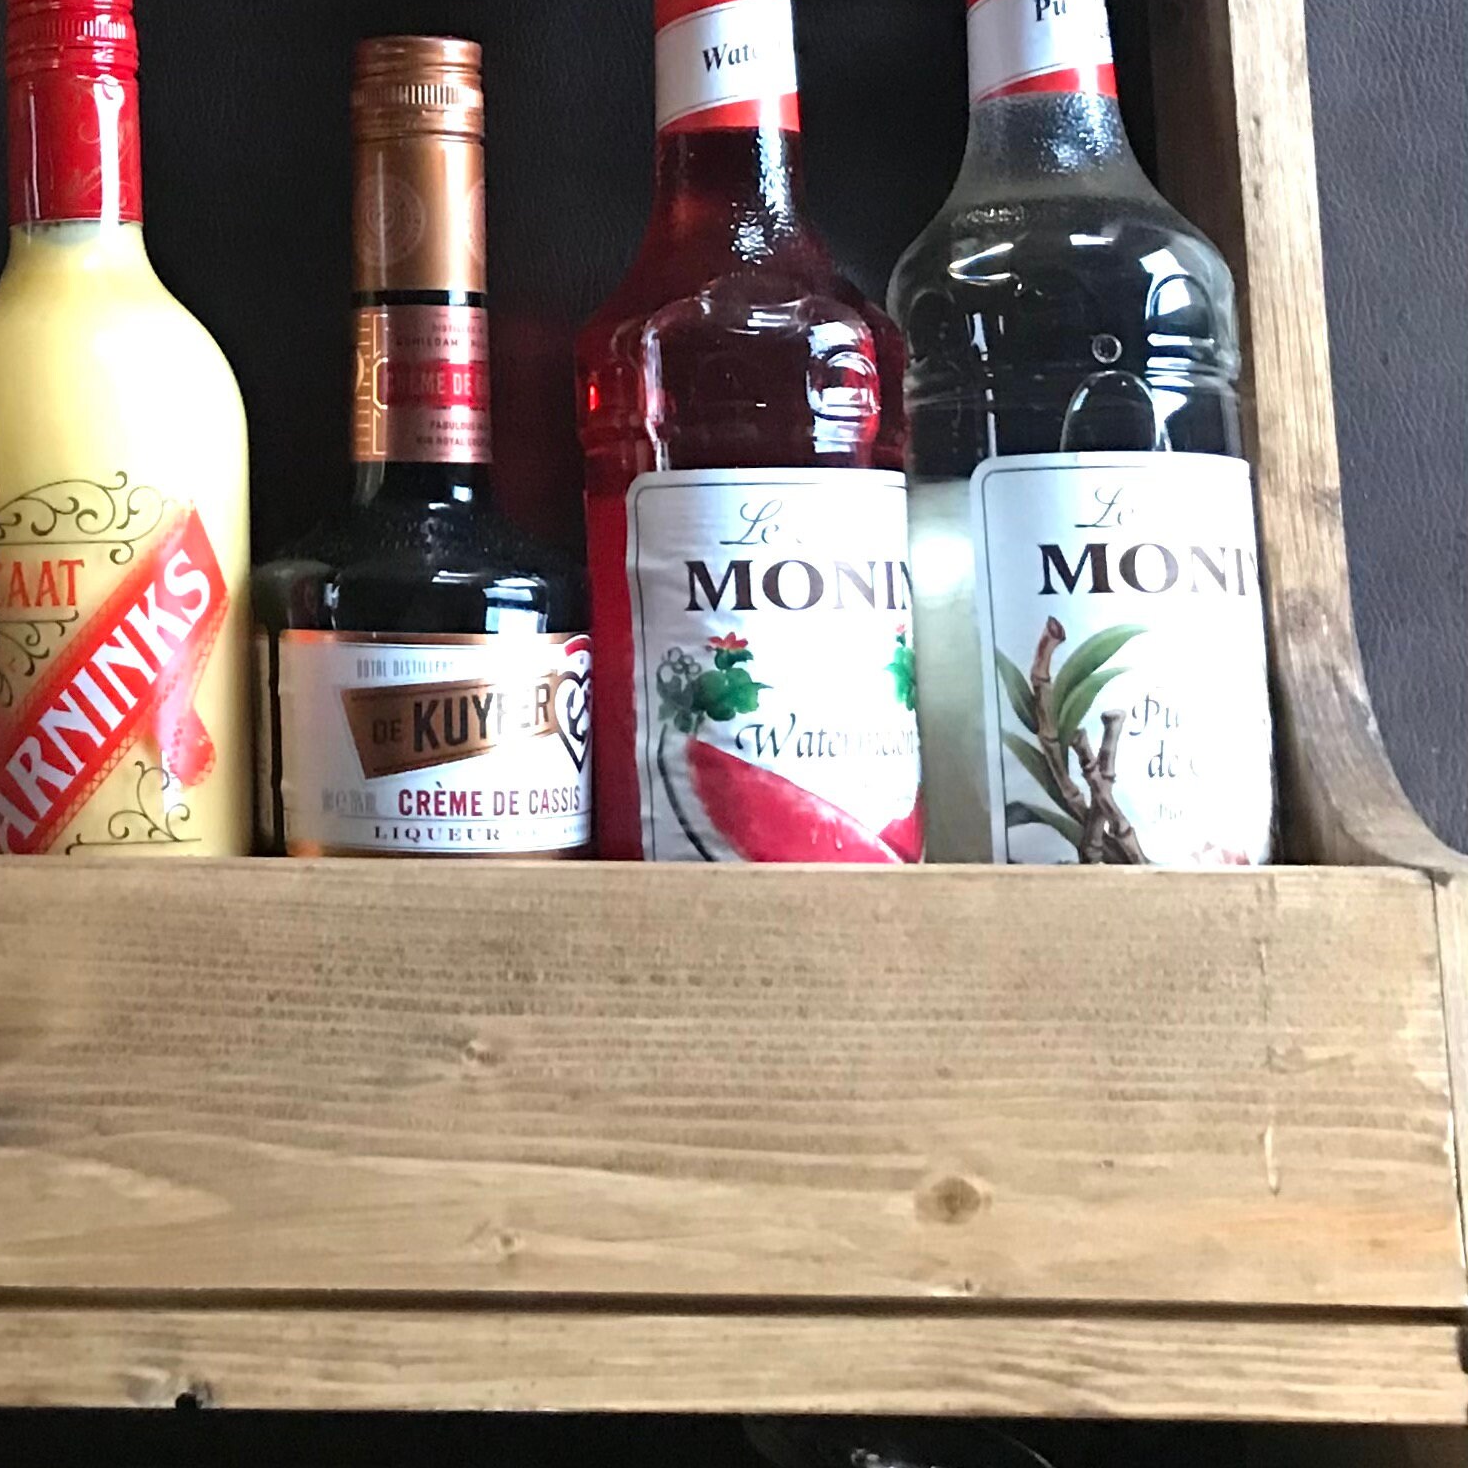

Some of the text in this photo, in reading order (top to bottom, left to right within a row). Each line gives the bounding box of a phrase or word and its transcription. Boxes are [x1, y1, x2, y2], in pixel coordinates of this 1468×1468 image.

[452, 372, 472, 395] DE
[372, 718, 403, 746] DE
[398, 780, 484, 817] CRÈME
[493, 790, 520, 816] DE
[528, 784, 582, 816] CASSIS
[374, 825, 501, 842] LIQUEUR
